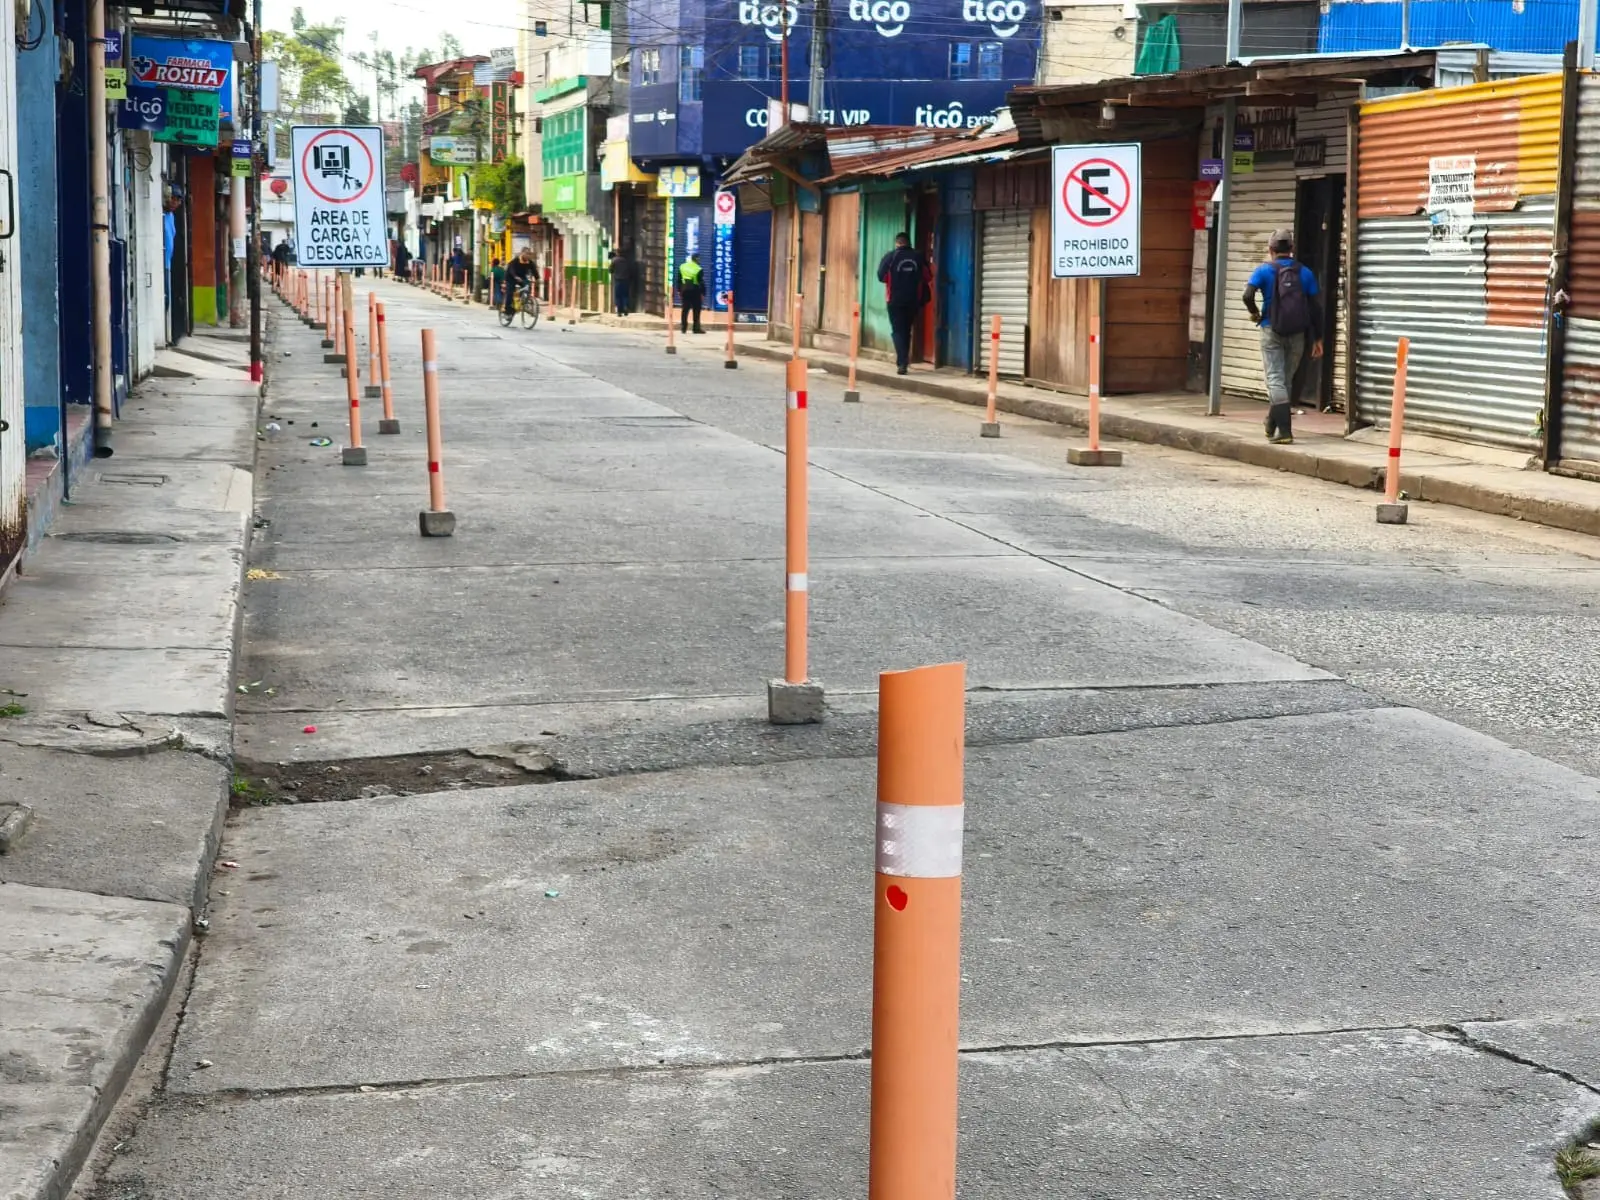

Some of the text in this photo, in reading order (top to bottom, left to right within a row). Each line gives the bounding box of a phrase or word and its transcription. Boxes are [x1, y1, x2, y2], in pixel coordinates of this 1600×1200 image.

[166, 57, 211, 69] FARMACIA
[155, 66, 219, 86] ROSITA
[180, 90, 195, 102] SE
[168, 102, 213, 117] VENDEN
[841, 109, 870, 126] VIP
[1082, 168, 1111, 216] E
[311, 206, 370, 225] ÁREA DE
[311, 228, 372, 243] CARGA Y
[1063, 238, 1129, 251] PROHIBIDO
[306, 245, 383, 260] DESCARGA
[1058, 255, 1134, 268] ESTACIONAR
